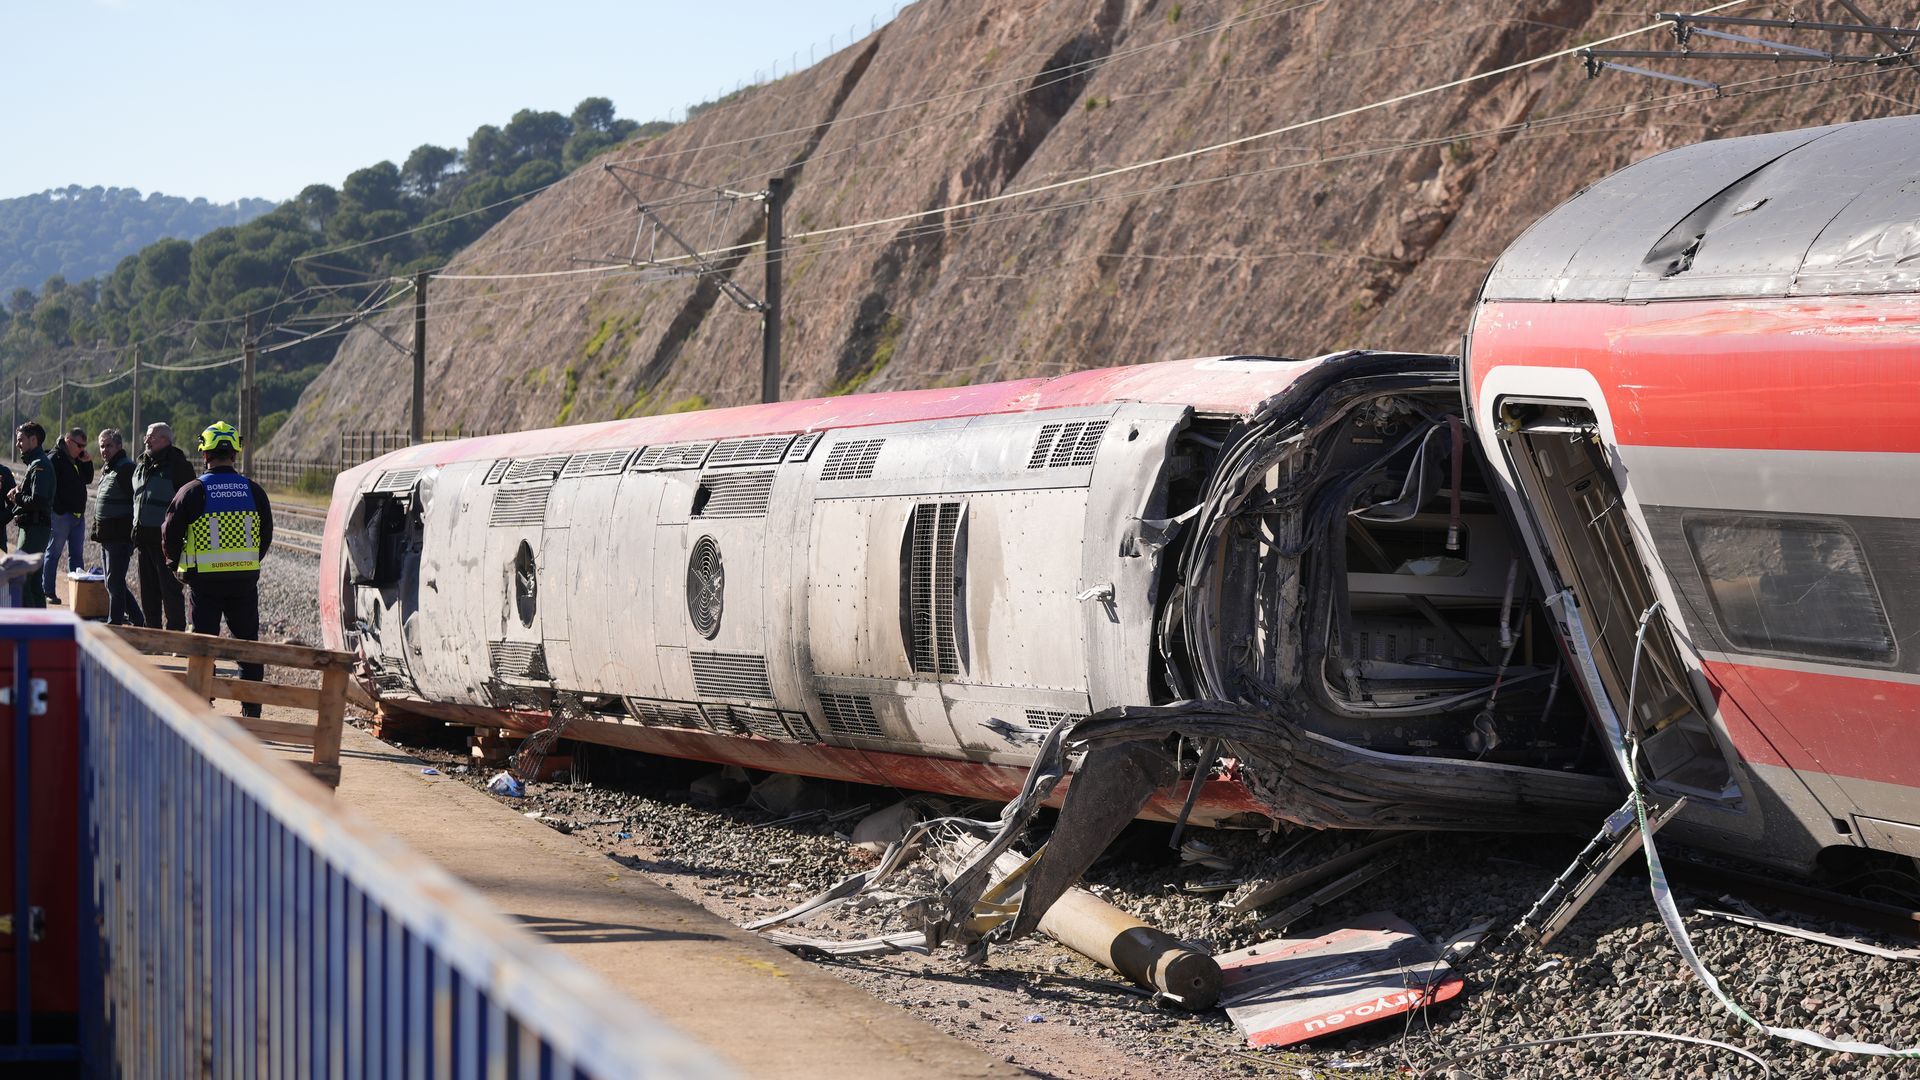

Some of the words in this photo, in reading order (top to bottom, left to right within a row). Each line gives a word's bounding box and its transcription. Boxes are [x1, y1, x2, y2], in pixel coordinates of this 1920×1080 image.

[207, 483, 249, 491] BOMBEROS
[211, 490, 248, 498] CÓRDOBA
[211, 560, 253, 568] SUBINSPECTOR
[1304, 991, 1421, 1033] iryo.eu
